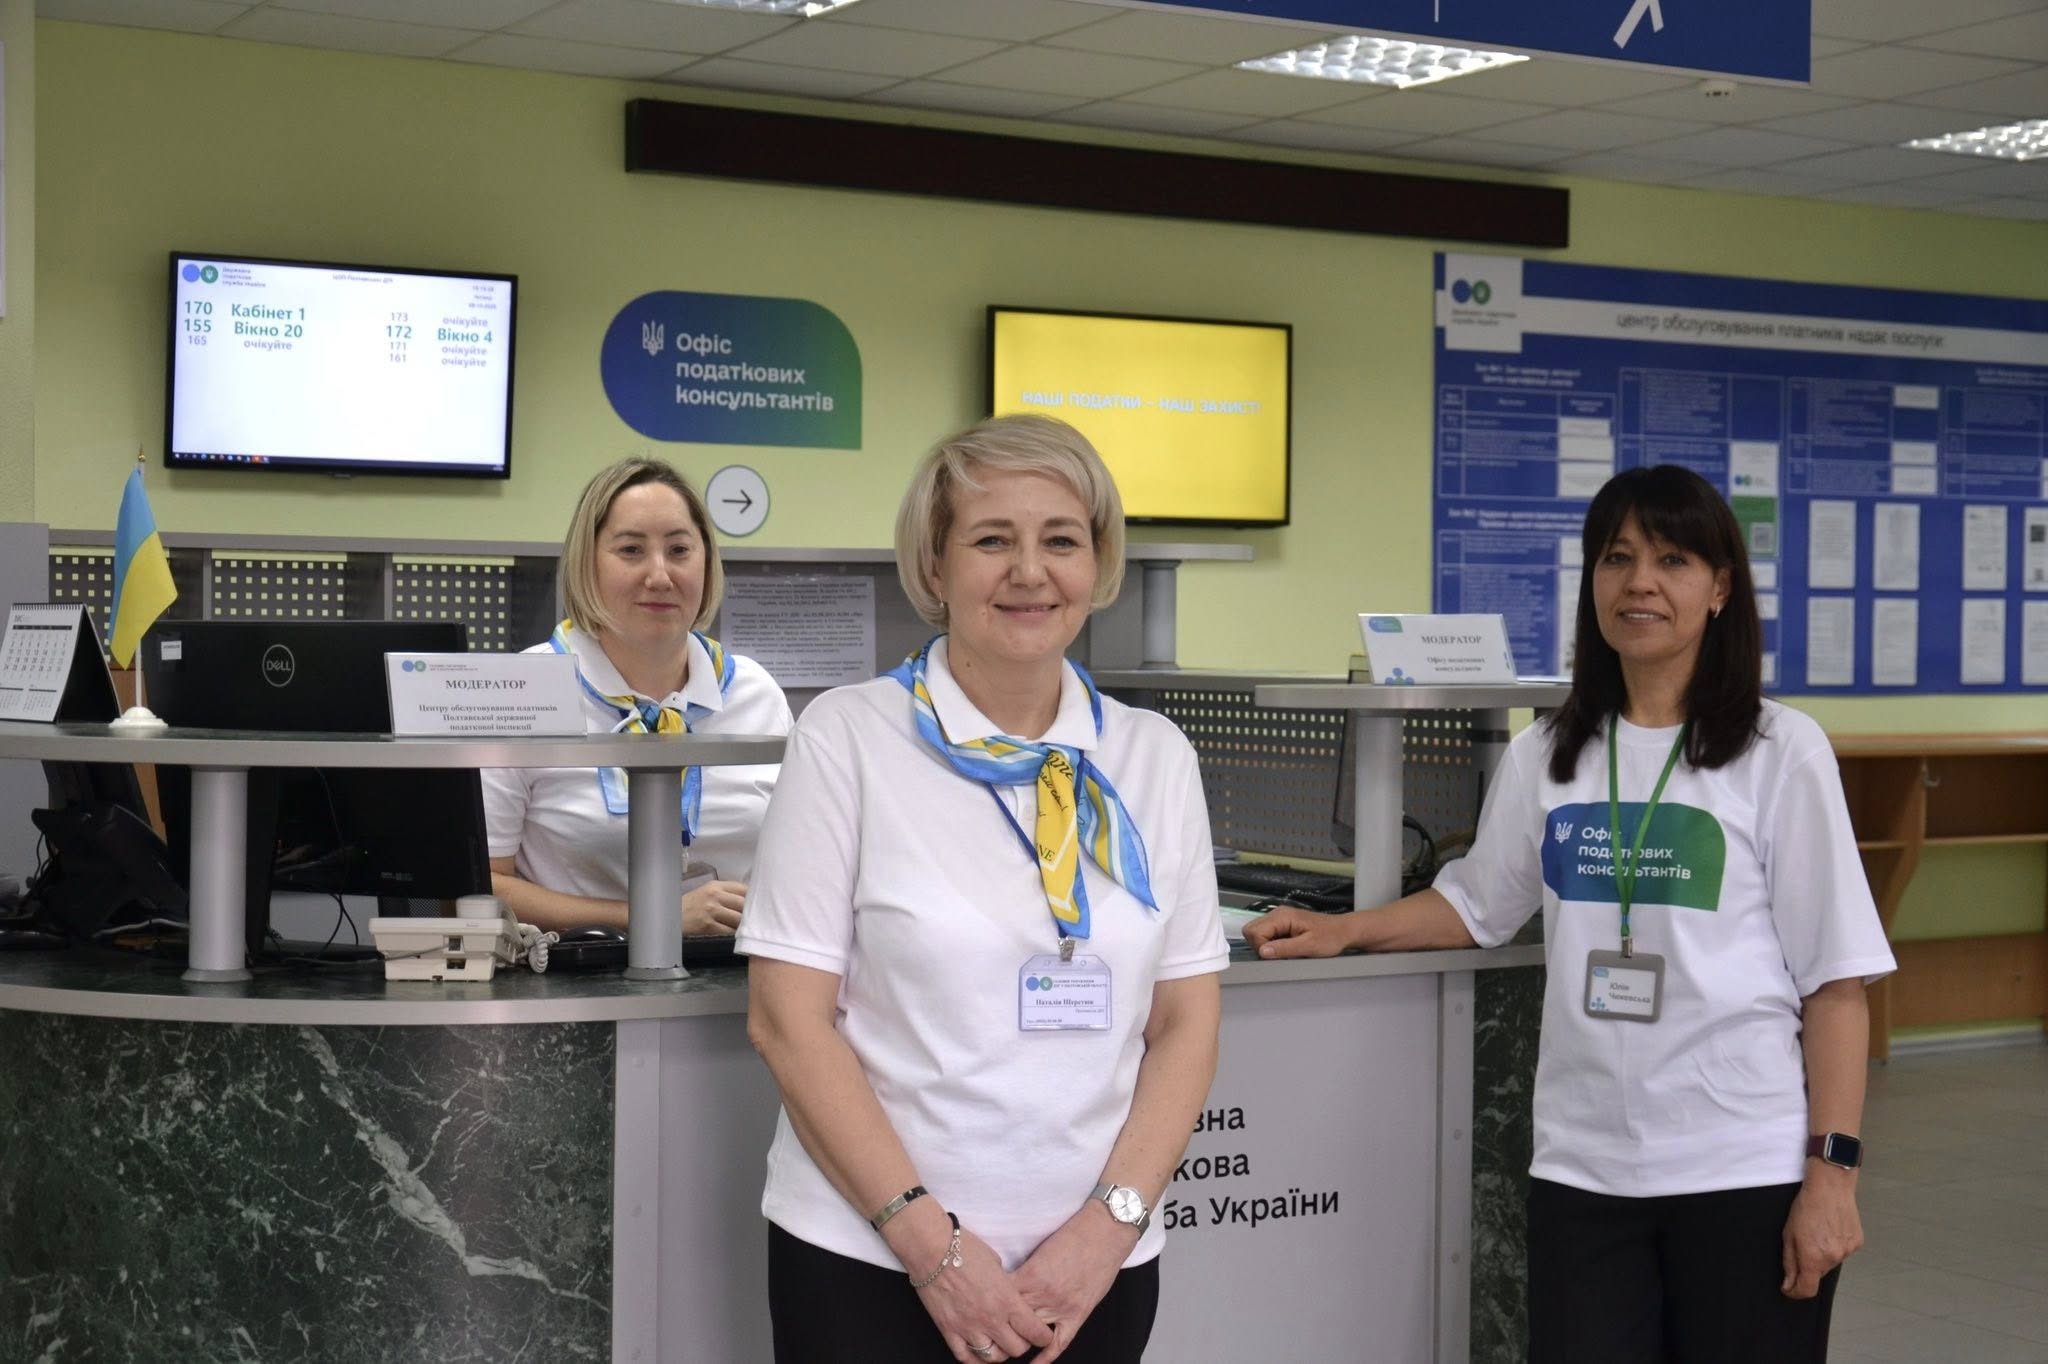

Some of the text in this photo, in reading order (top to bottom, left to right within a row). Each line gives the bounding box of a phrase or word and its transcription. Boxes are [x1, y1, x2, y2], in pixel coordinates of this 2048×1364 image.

[184, 301, 306, 321] 170 Кабінет 1
[390, 311, 488, 329] 173 очікуйте
[184, 318, 303, 339] 155 Вікно 20
[386, 325, 493, 344] 172 Вікно 4
[187, 334, 292, 352] 165 очікуйте
[389, 341, 488, 357] 171 очікуйте
[675, 333, 732, 357] Офіс
[441, 356, 487, 369] очікуйте
[675, 362, 806, 385] податкових
[675, 384, 835, 411] консультантів
[1021, 391, 1063, 406] НАШІ
[1069, 392, 1141, 410] ПОДАТКИ
[1159, 396, 1195, 412] НАШ
[1420, 635, 1483, 645] МОДЕРАТОР
[266, 659, 291, 671] DELL
[445, 679, 528, 691] МОДЕРАТОР
[418, 704, 448, 713] Центру
[516, 704, 558, 712] платників
[1208, 1187, 1340, 1229] України
